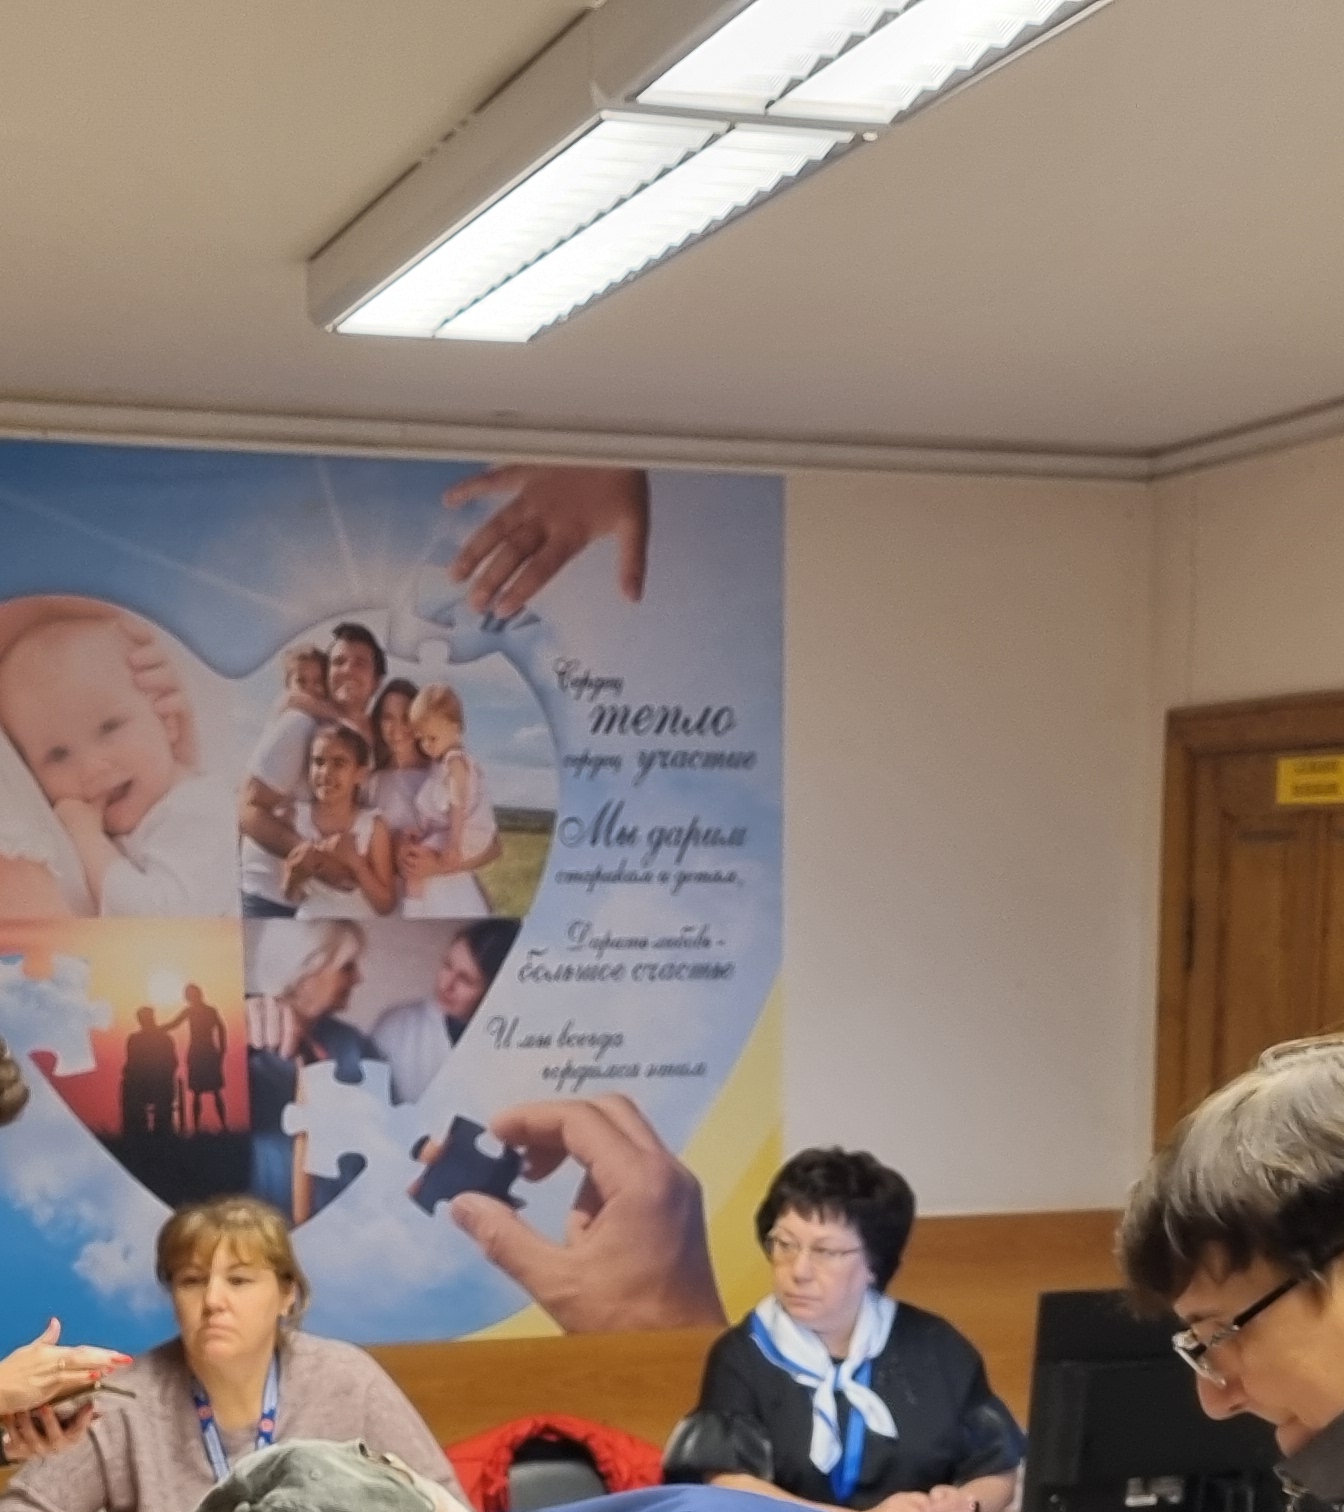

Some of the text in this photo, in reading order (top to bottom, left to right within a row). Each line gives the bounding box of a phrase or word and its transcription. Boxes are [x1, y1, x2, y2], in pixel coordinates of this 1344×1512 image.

[588, 703, 737, 737] тепло
[631, 749, 758, 788] участие
[557, 798, 747, 868] Мы дарим
[517, 947, 737, 983] большое счастье
[556, 1017, 623, 1062] всегда
